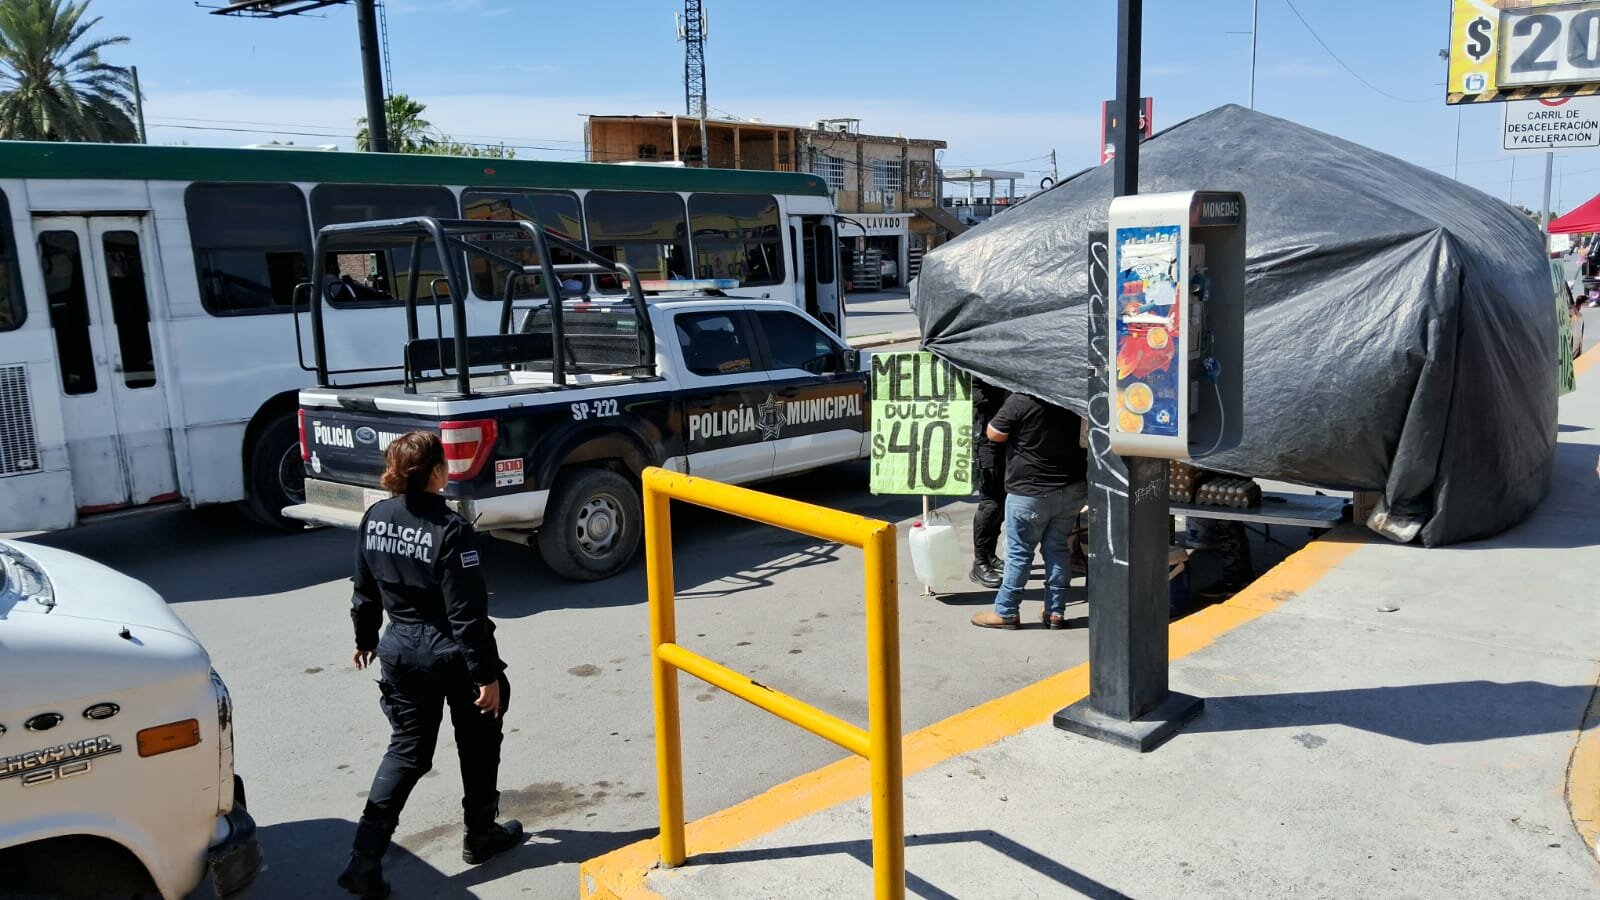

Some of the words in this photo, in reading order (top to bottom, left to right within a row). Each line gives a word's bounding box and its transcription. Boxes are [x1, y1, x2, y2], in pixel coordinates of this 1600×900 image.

[1467, 16, 1492, 61] $
[1528, 110, 1563, 120] CARRIL
[1566, 109, 1580, 119] DE
[1508, 120, 1598, 133] DESACELERACIÓN
[1513, 135, 1519, 144] Y
[1521, 131, 1592, 143] ACELERACIÓN
[863, 191, 882, 204] BAR
[1202, 201, 1240, 217] MONEDAS
[866, 217, 900, 229] LAVADO
[871, 353, 972, 401] MELON
[689, 403, 756, 440] POLICÍA
[786, 393, 863, 425] MUNICIPAL
[885, 402, 949, 419] DULCE
[314, 424, 355, 448] POLICÍA
[953, 425, 972, 483] BOLSA
[497, 461, 522, 471] 911
[367, 520, 433, 547] POLICÍA
